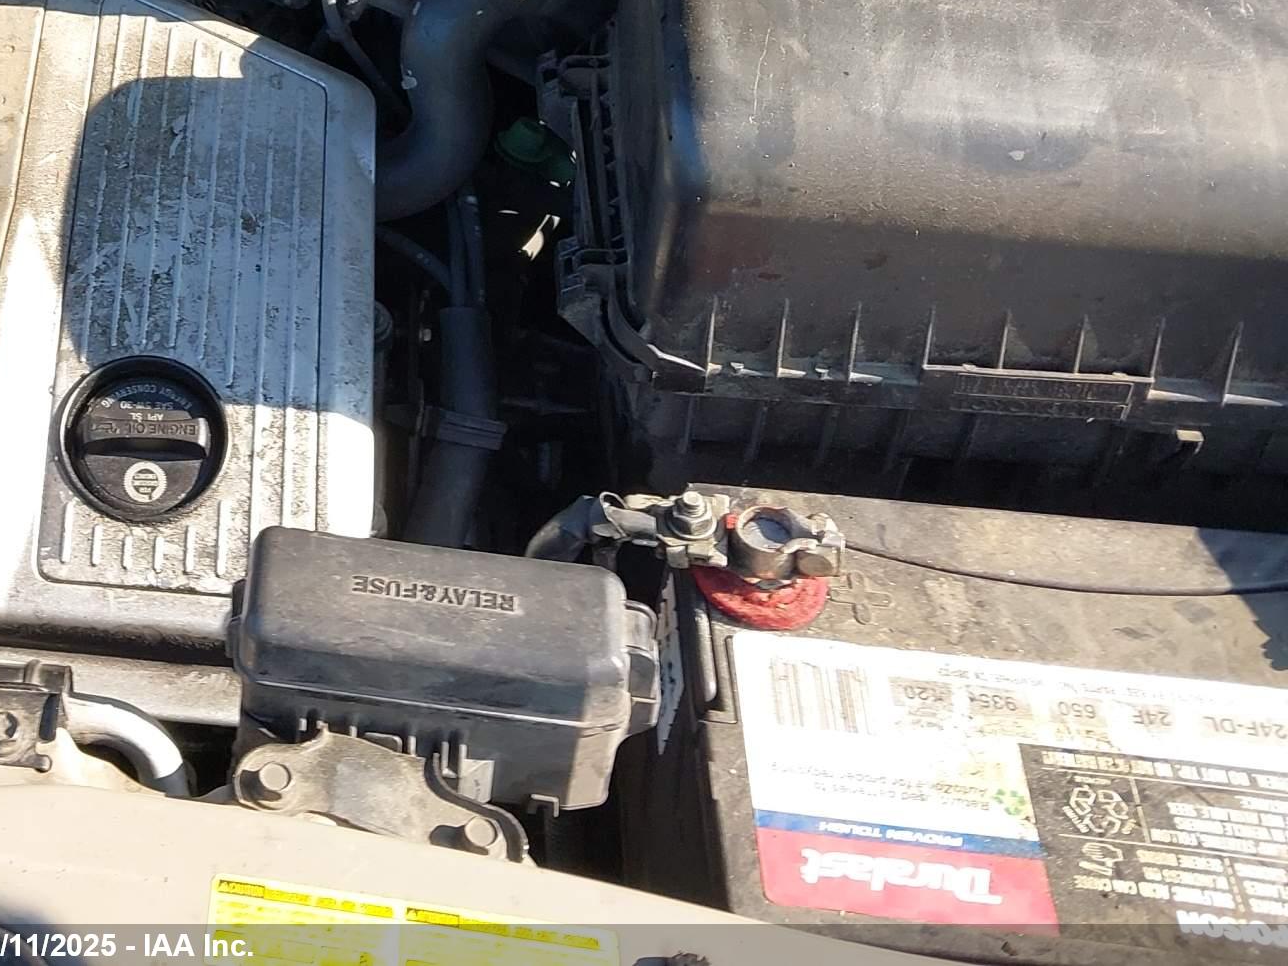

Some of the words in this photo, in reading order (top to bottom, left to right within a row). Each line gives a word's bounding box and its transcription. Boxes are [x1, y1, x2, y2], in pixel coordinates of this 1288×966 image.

[101, 384, 157, 408] CONSERVING
[120, 400, 152, 410] 5W-30
[154, 402, 174, 410] SAE
[147, 413, 164, 422] API
[126, 421, 146, 435] OIL
[150, 422, 197, 436] ENGINE
[351, 575, 516, 613] RELAY&FUSE
[1058, 700, 1098, 720] 650
[1133, 708, 1173, 727] 24F
[1203, 715, 1288, 740] 24F-DL
[819, 821, 882, 838] TOUGH
[885, 829, 963, 847] PROVEN
[800, 847, 1003, 906] Duralast
